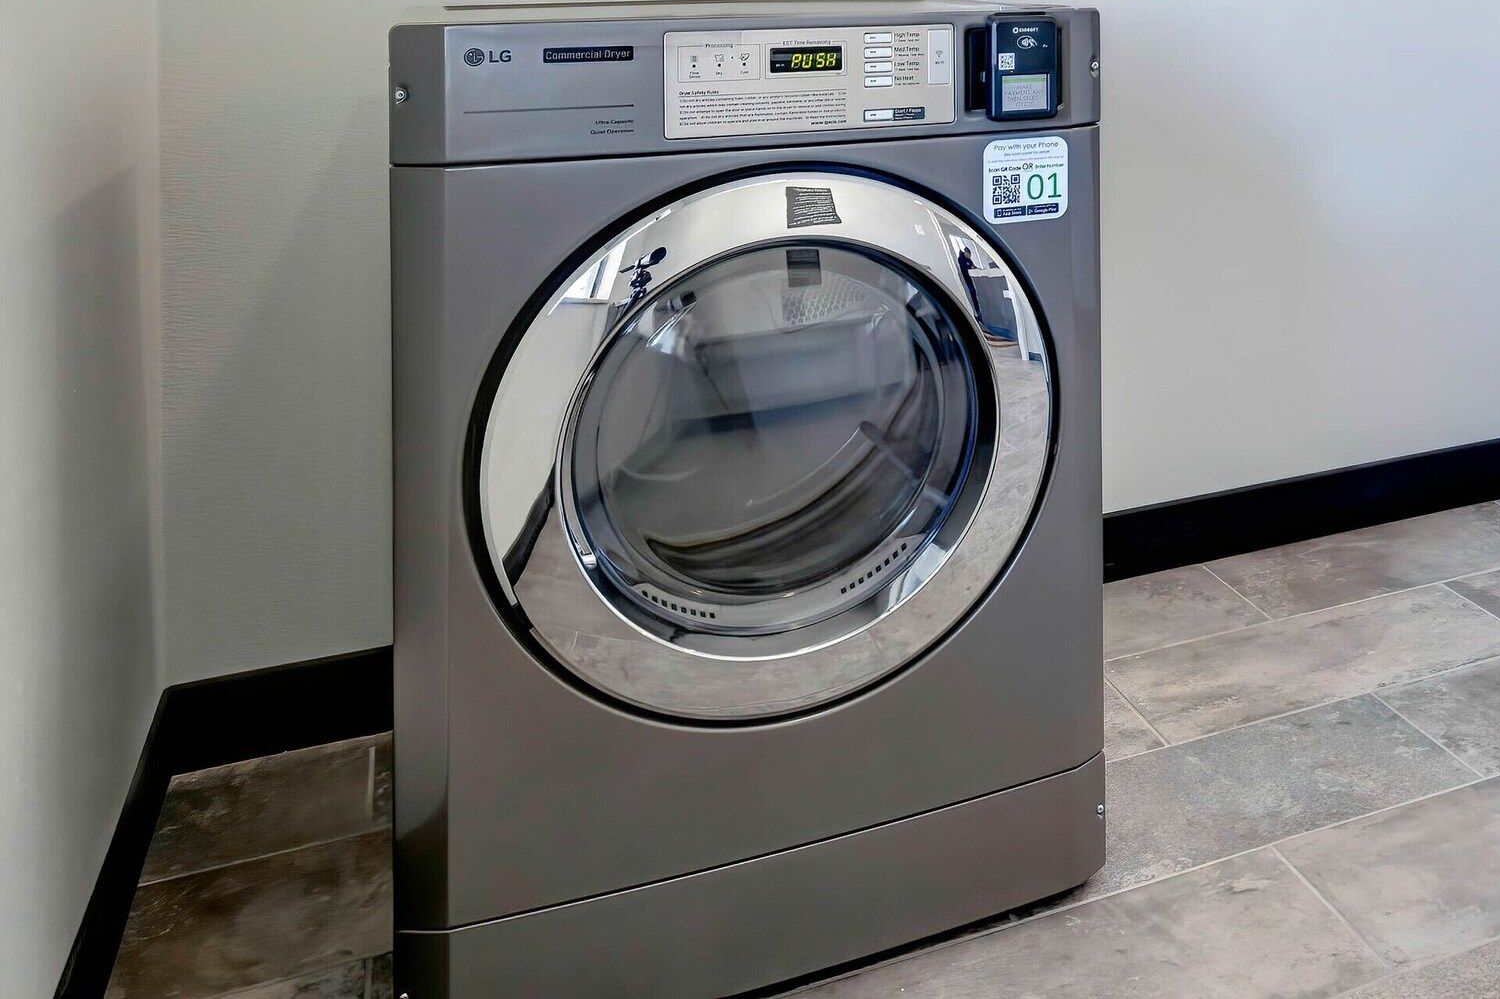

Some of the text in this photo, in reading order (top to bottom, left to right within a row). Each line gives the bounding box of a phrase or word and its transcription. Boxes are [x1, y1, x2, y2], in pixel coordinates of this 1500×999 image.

[489, 50, 512, 63] LG
[545, 50, 631, 61] Commercial Dryer
[791, 52, 837, 68] PUSH
[1022, 143, 1037, 151] your
[1022, 162, 1034, 170] OR
[1027, 172, 1062, 200] 01
